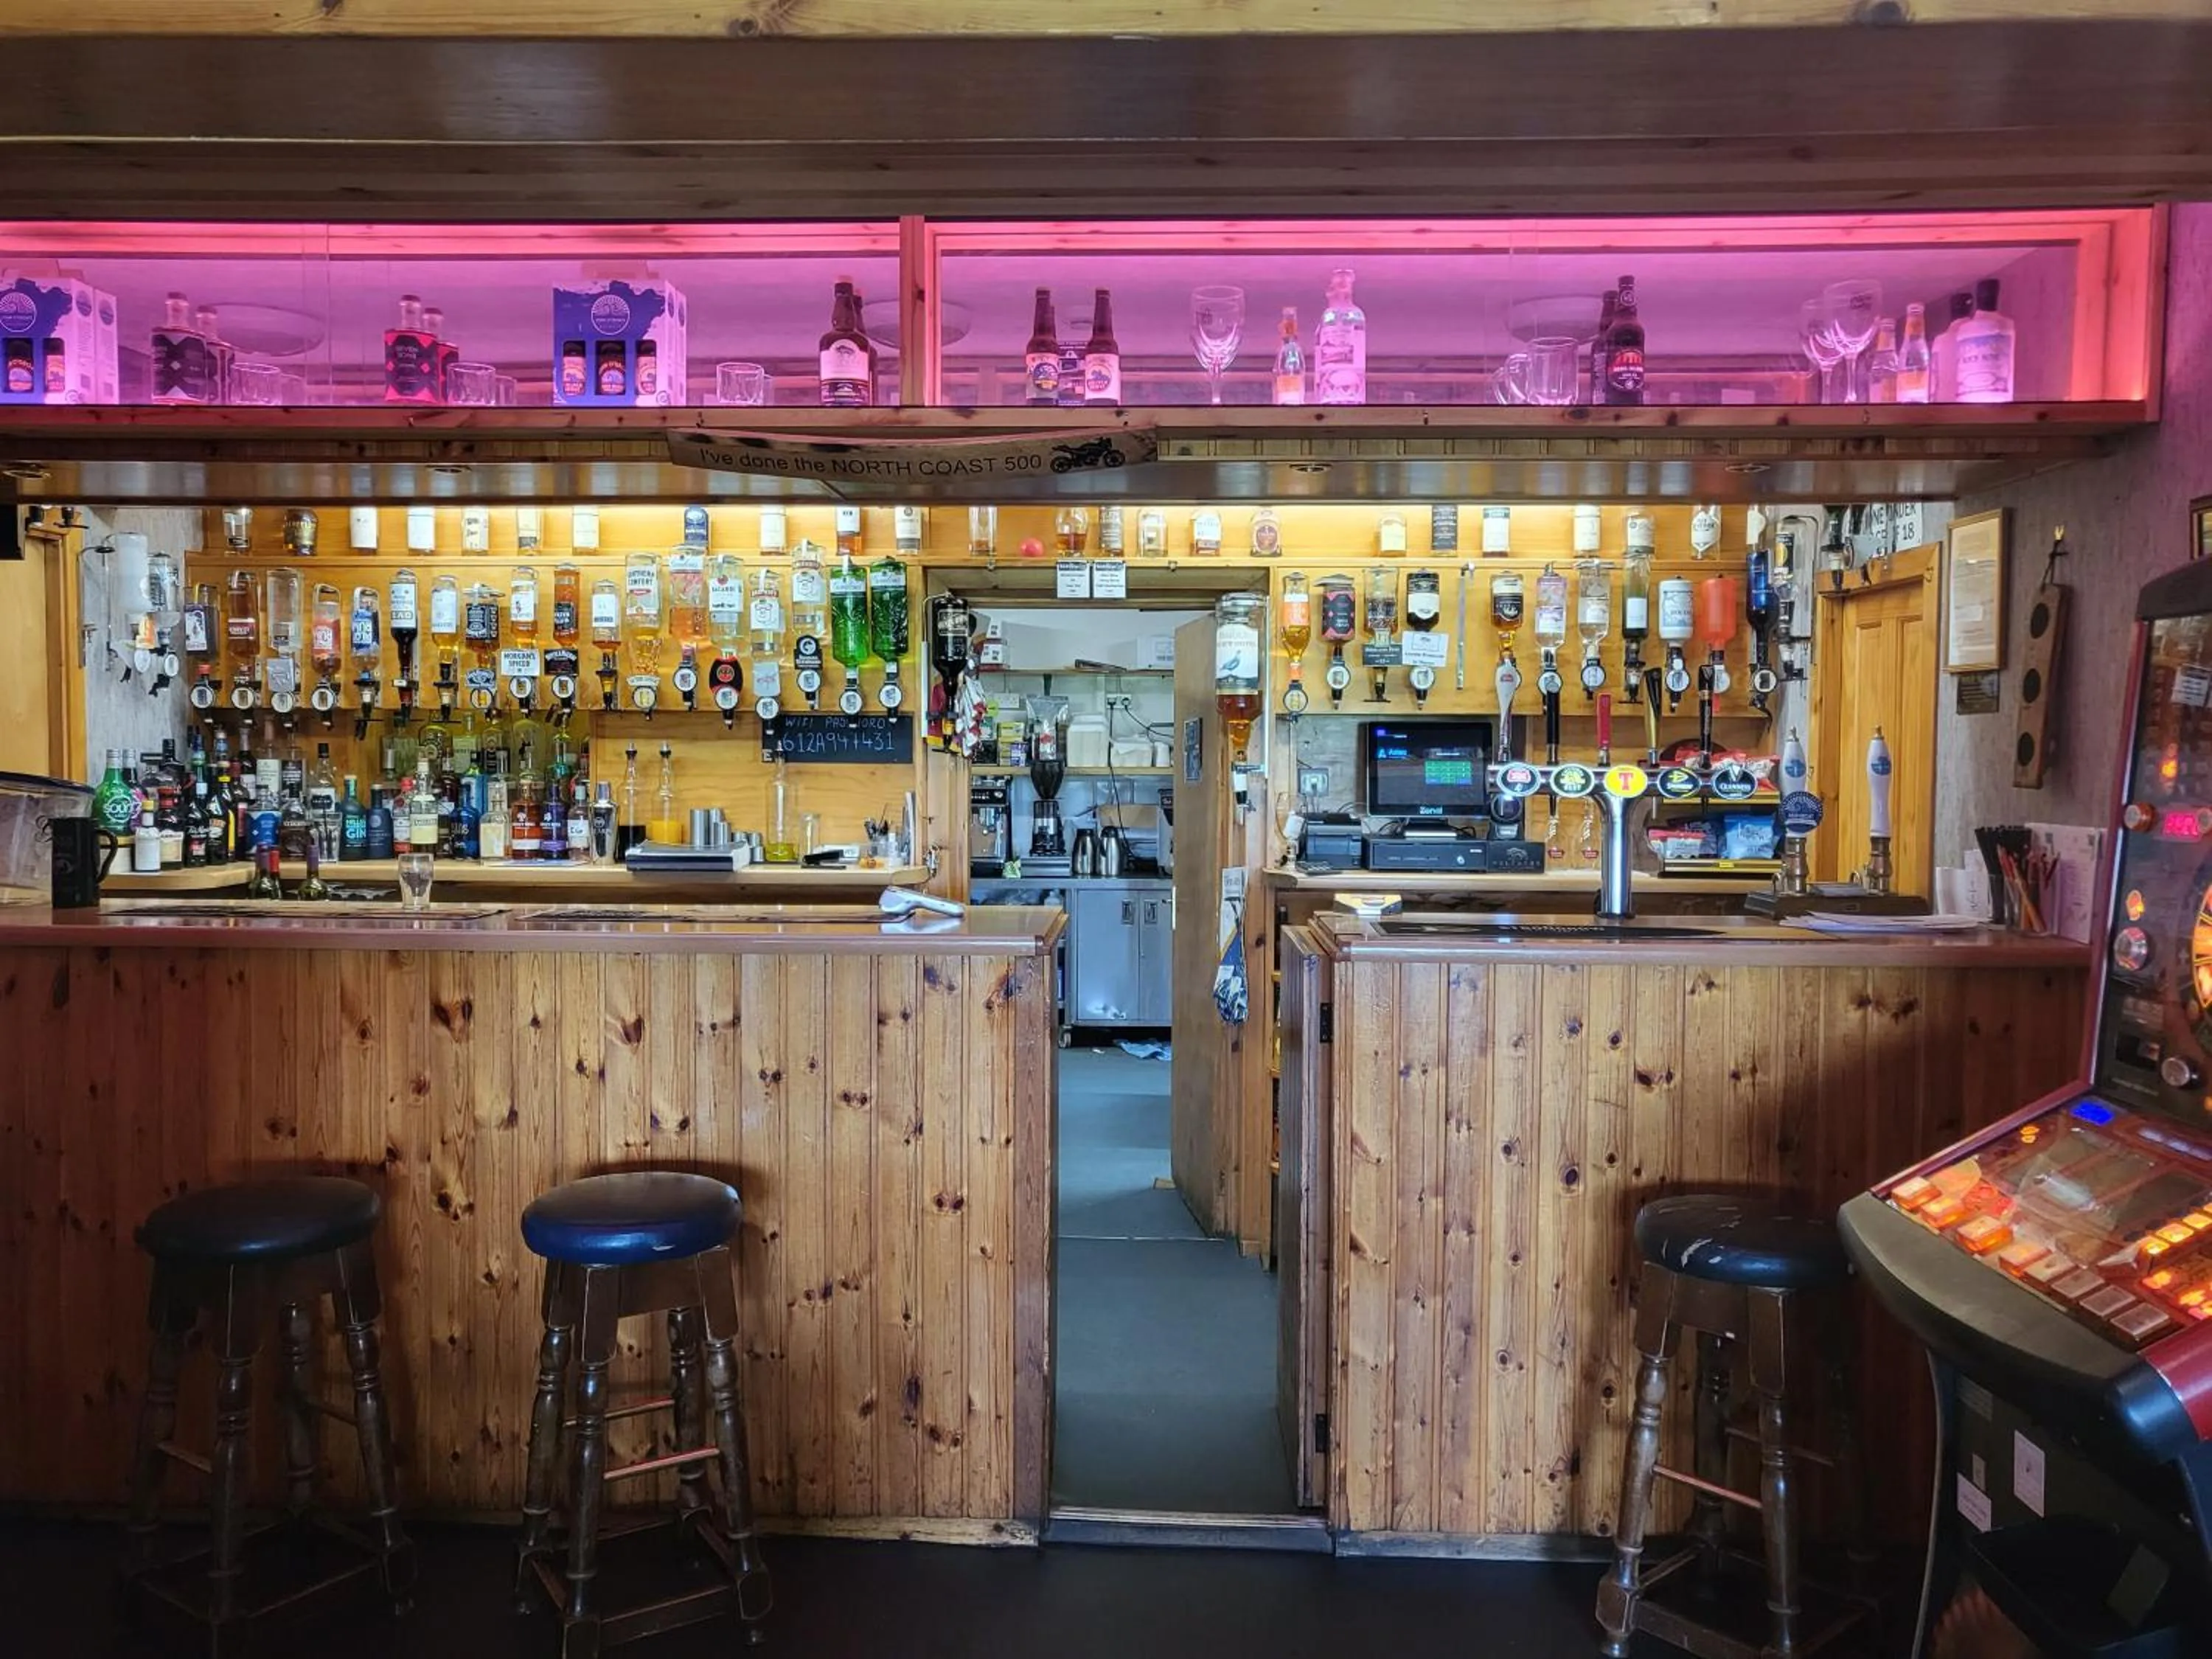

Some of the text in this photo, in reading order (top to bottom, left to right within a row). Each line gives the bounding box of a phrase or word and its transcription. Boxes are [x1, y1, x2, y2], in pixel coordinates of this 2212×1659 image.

[700, 448, 1042, 476] I've done the NORTH COAST 500
[1903, 521, 1915, 540] 18
[785, 717, 886, 728] WIFI PASORD
[1619, 773, 1633, 791] T
[346, 829, 366, 839] GIN
